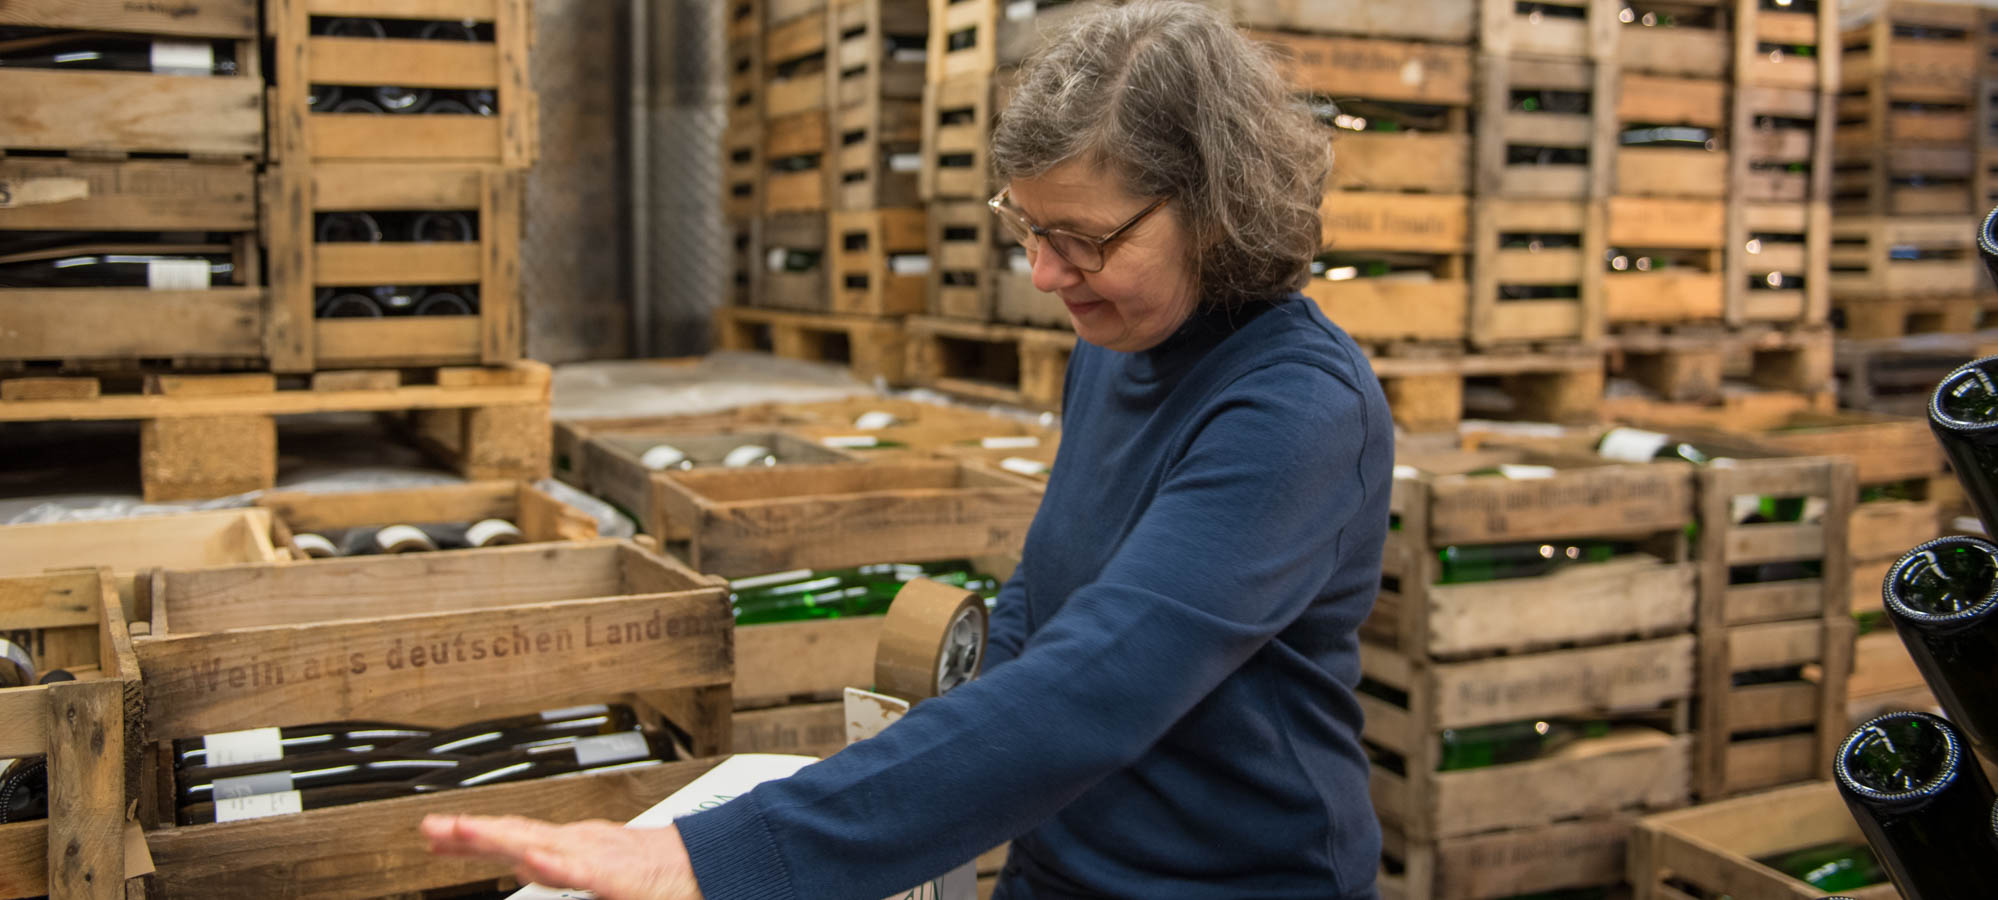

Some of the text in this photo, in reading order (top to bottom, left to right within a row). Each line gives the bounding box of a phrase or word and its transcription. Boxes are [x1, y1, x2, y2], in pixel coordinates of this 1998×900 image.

[191, 609, 700, 692] Wein aus deutschen Landen
